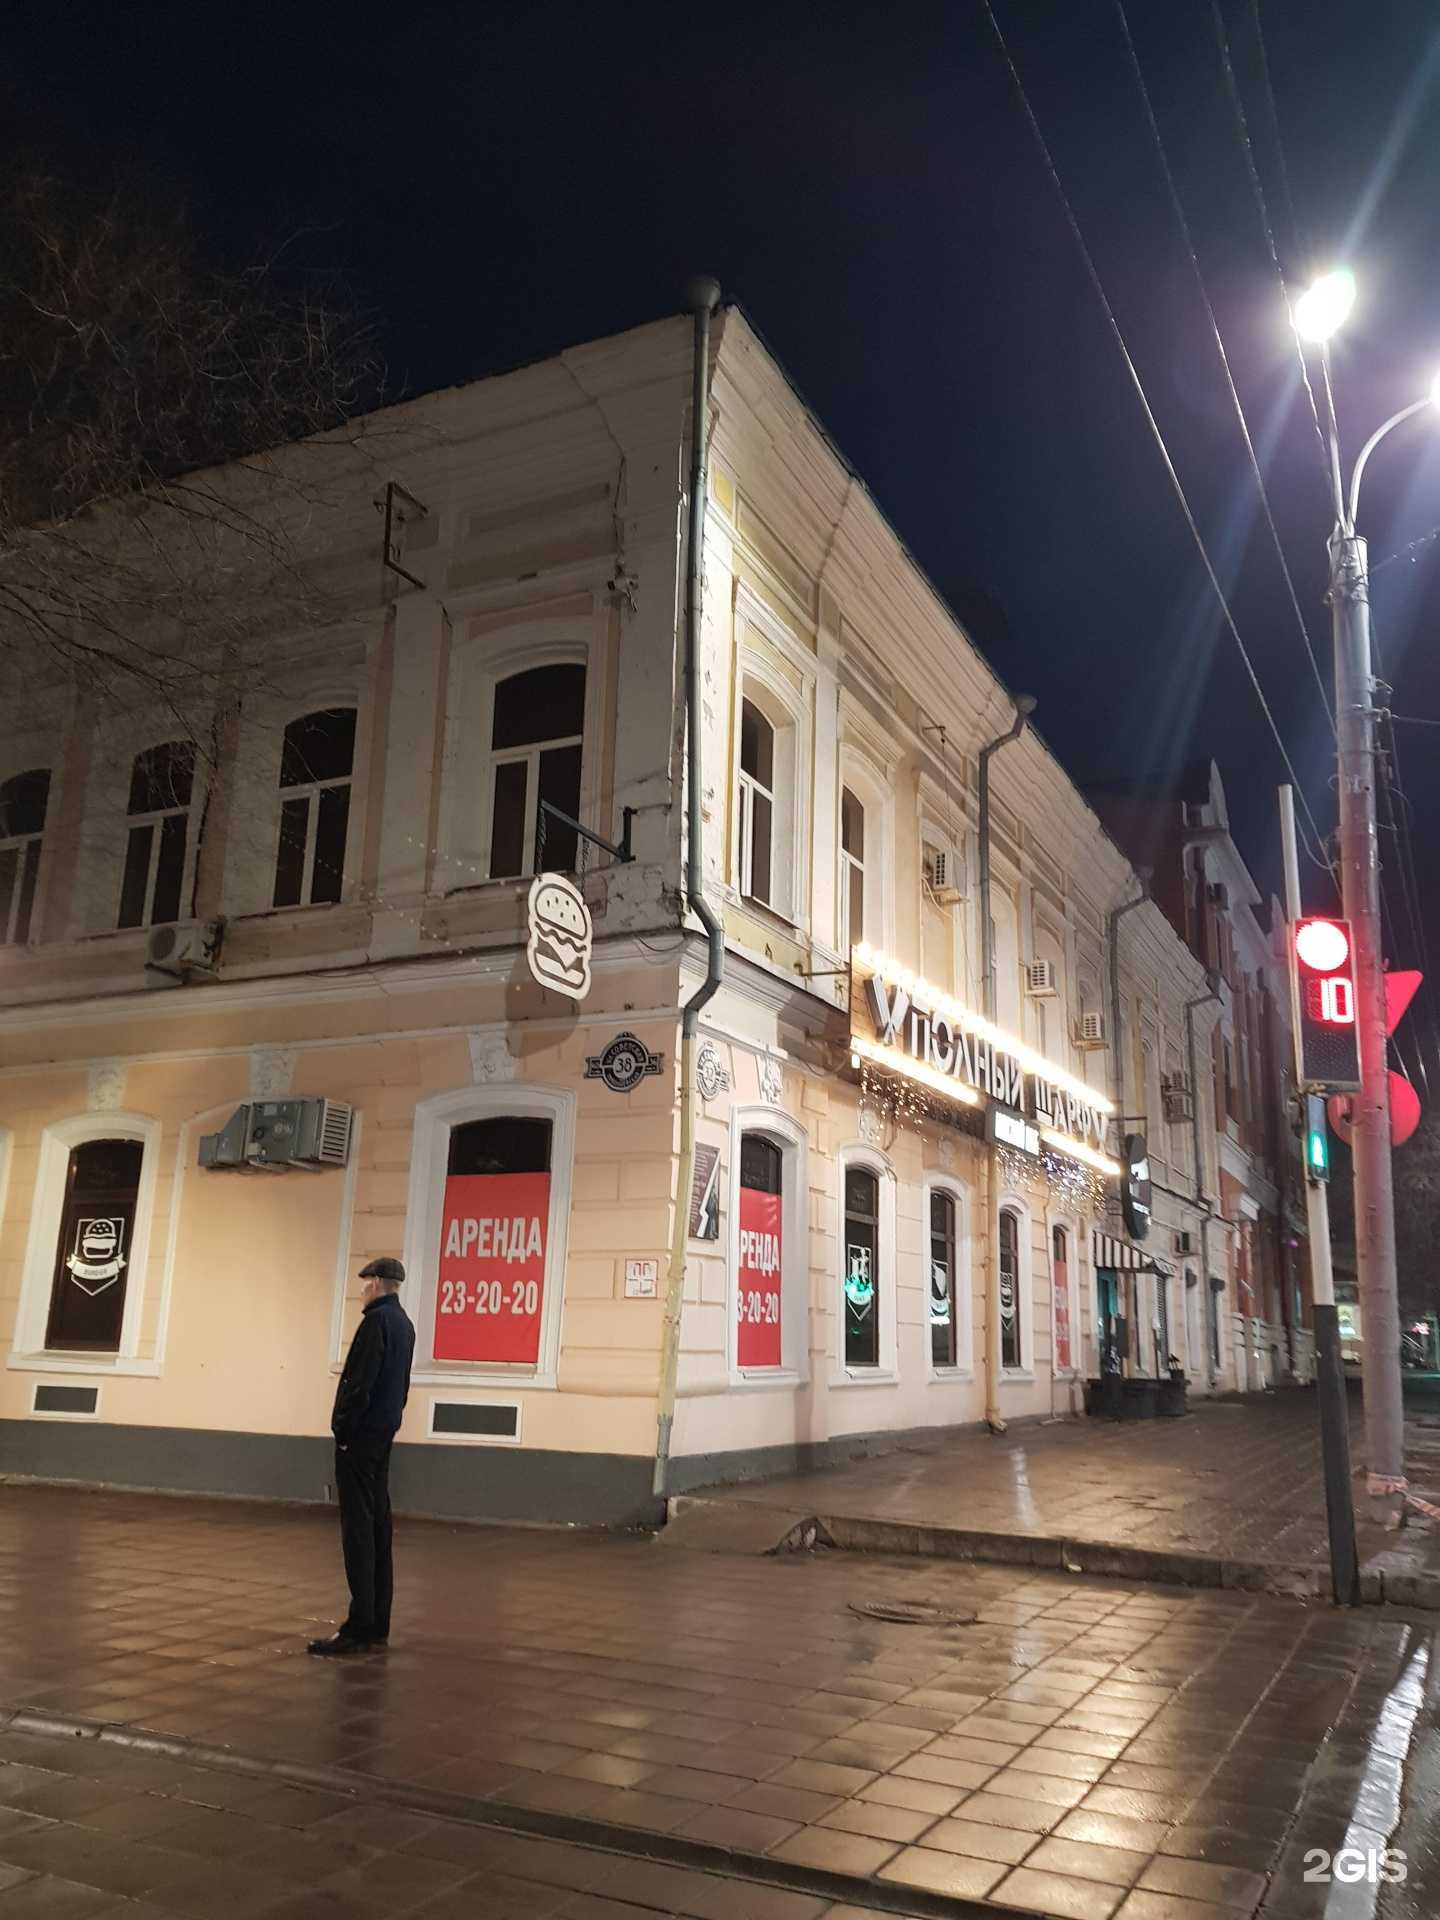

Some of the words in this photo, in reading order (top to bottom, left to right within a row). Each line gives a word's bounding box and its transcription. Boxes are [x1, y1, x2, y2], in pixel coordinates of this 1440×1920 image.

[1320, 976, 1354, 1023] 10
[444, 1216, 543, 1264] АРЕНДА
[440, 1280, 538, 1315] 23-20-20
